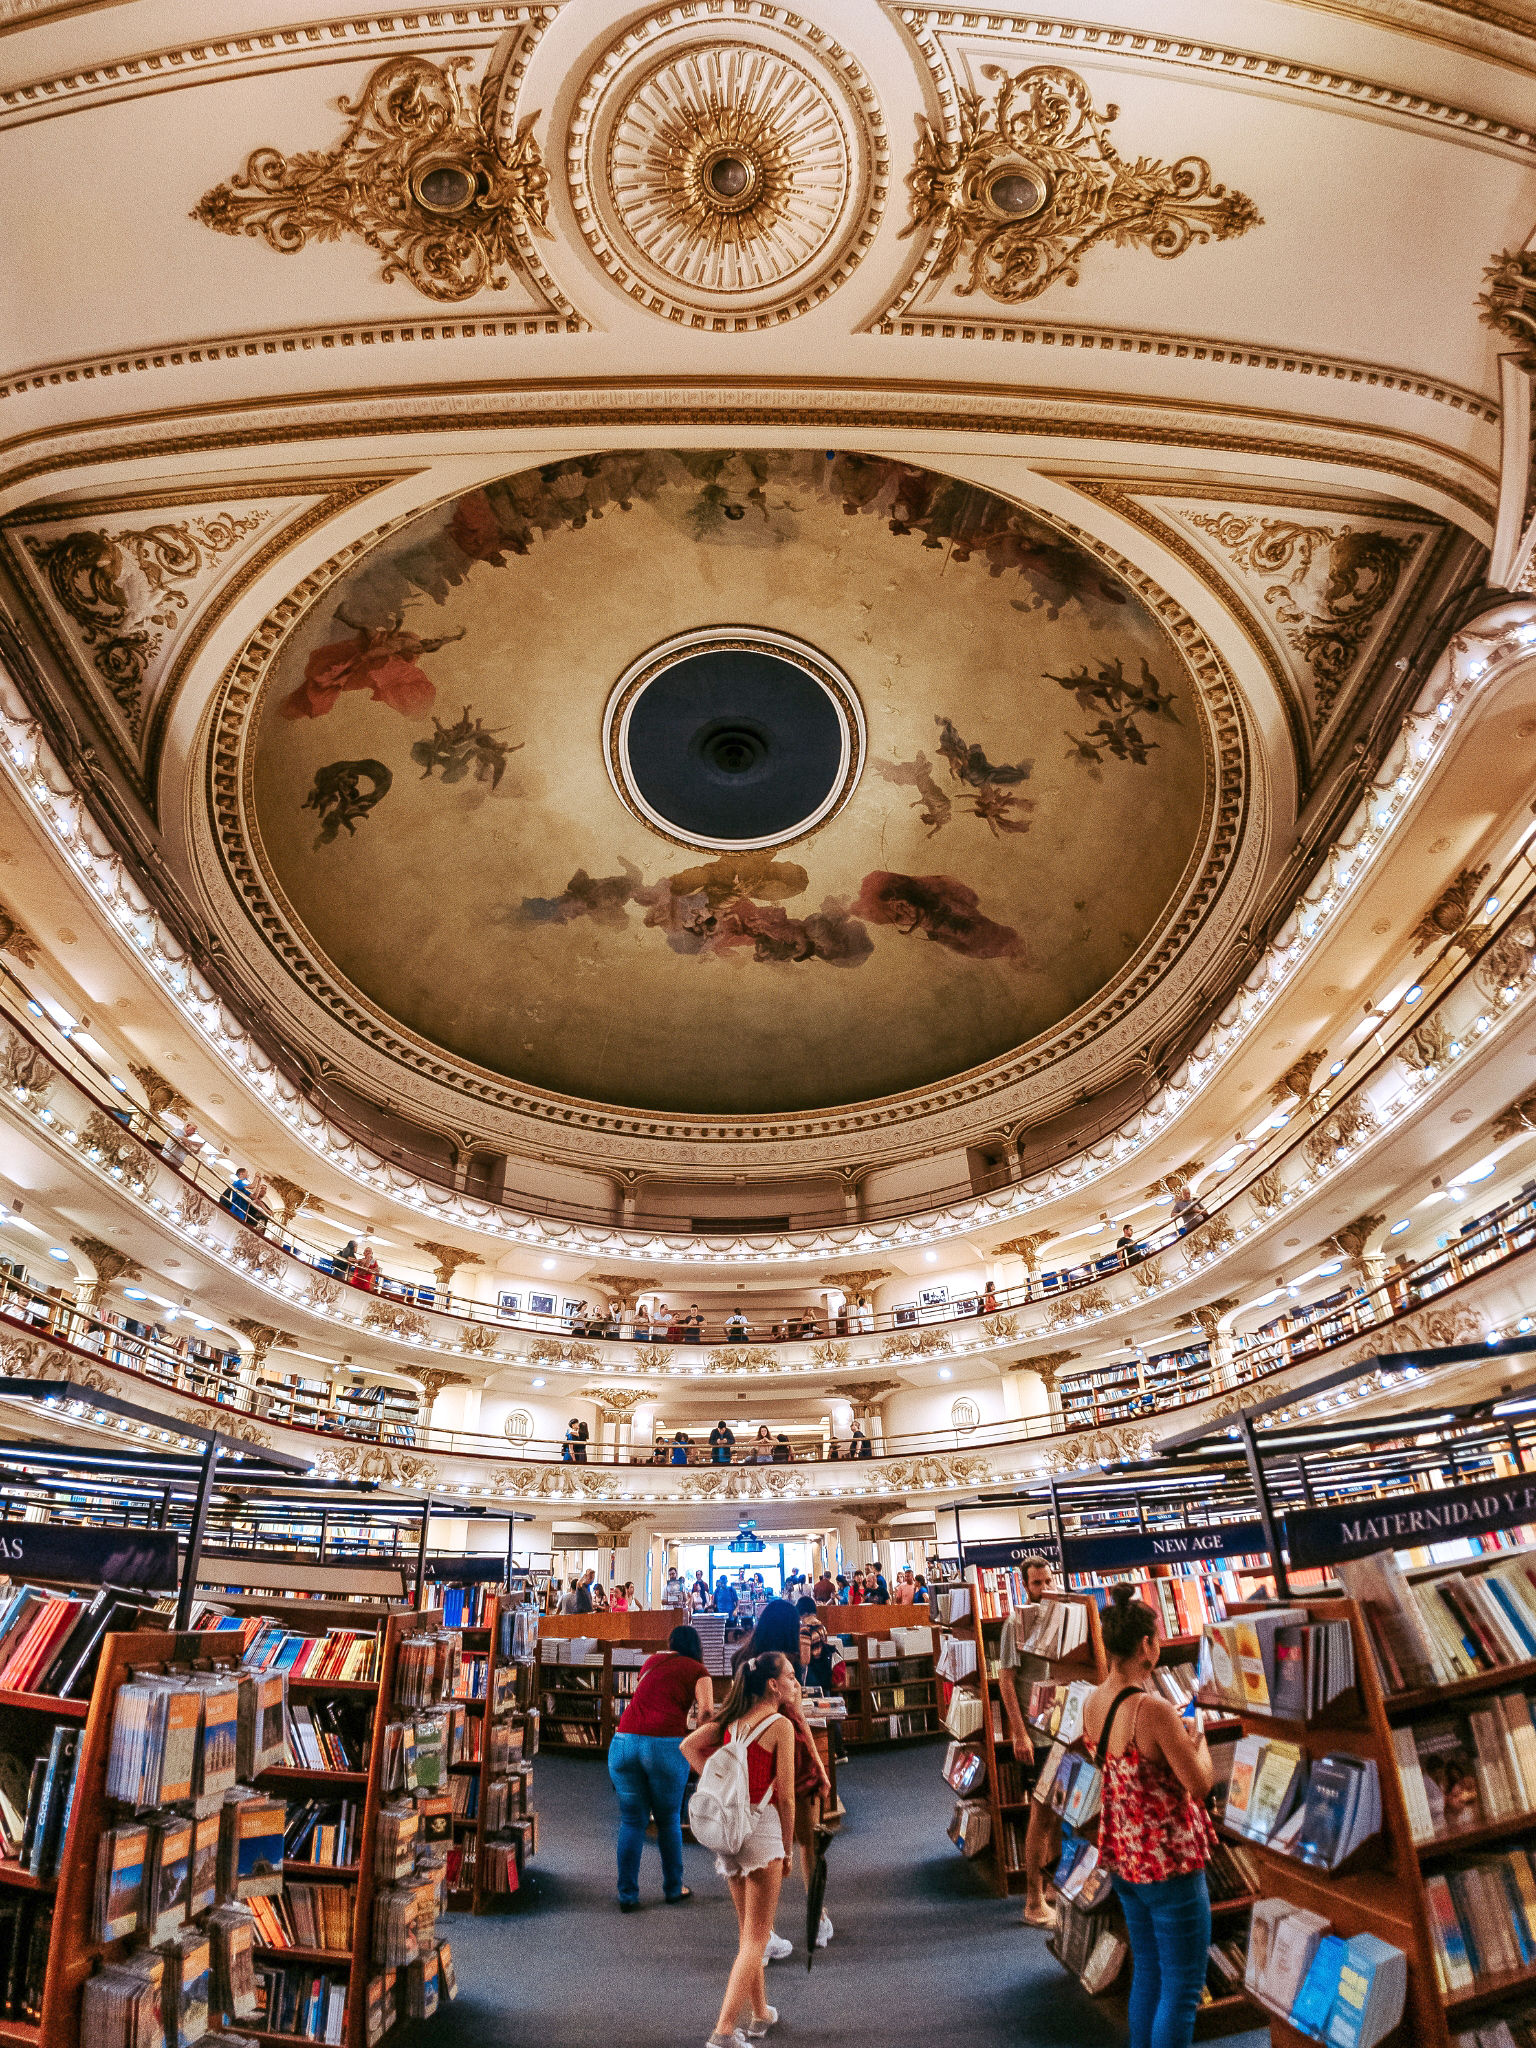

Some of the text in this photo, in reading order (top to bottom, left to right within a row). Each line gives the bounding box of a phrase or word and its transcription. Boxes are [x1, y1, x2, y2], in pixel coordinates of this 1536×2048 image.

[1341, 1496, 1499, 1544] MATERNIDAD
[1503, 1491, 1517, 1511] Y
[1011, 1545, 1061, 1559] ORIENTA
[1152, 1535, 1224, 1554] NEW AGE
